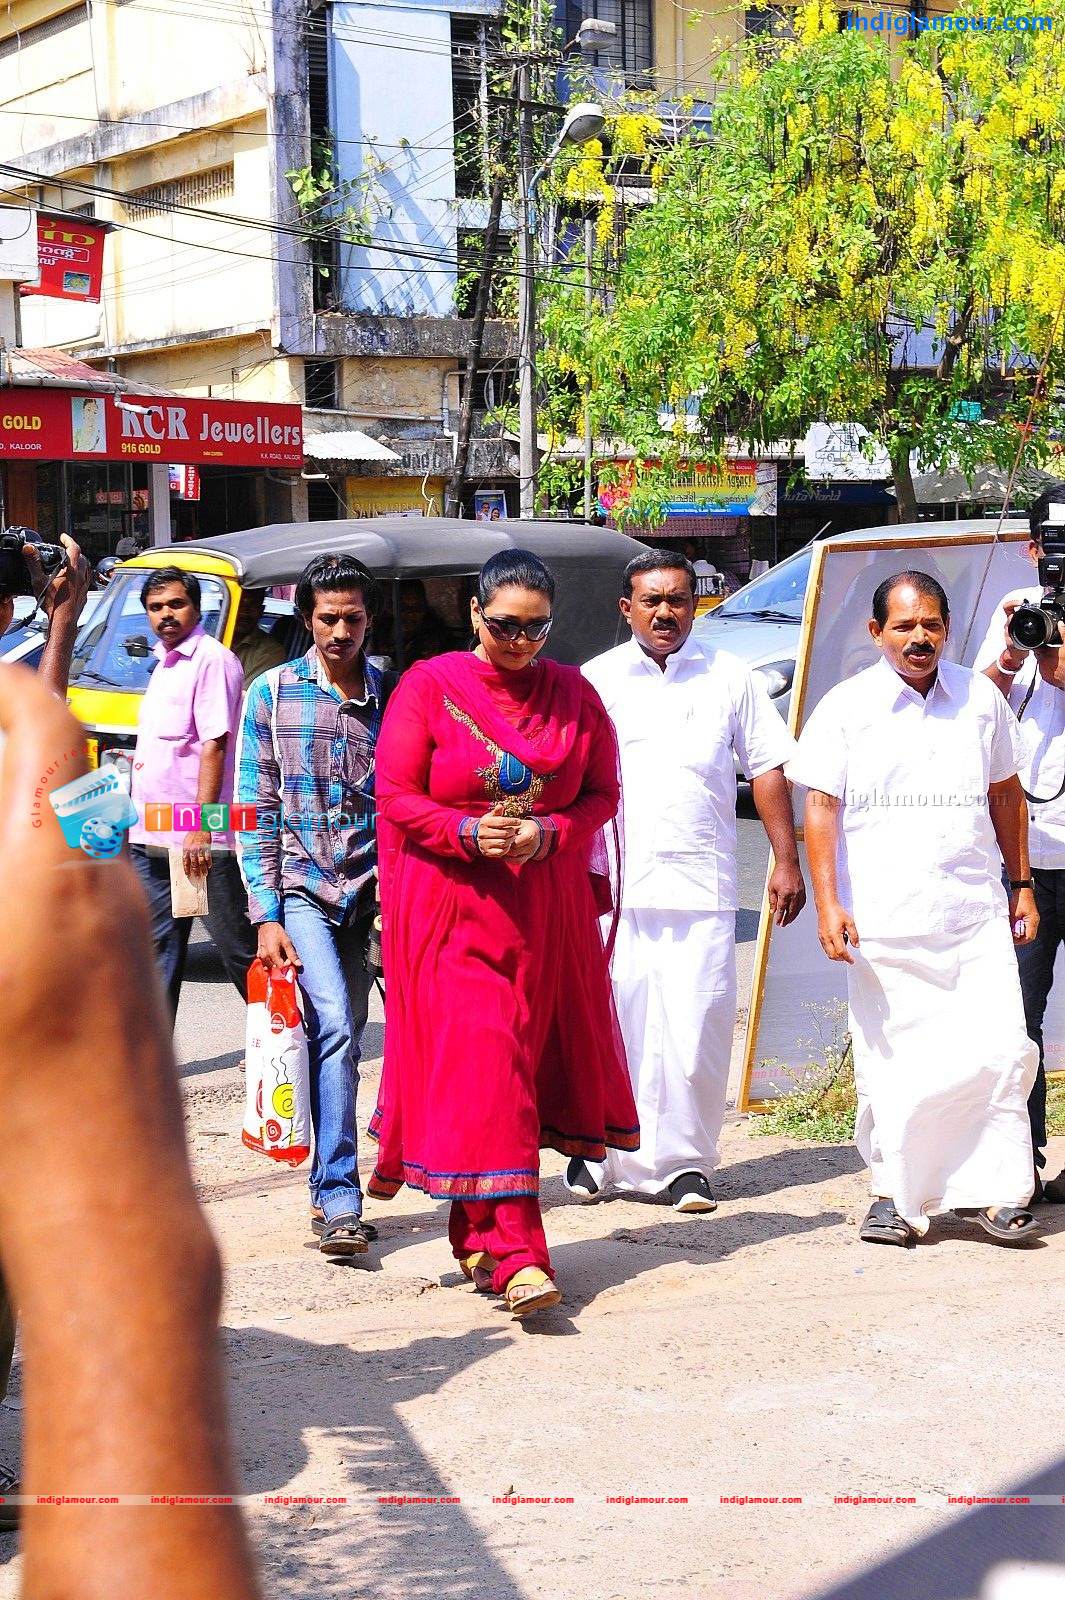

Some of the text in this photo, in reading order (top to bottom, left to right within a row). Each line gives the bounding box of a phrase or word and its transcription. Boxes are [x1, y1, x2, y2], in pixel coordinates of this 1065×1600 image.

[2, 415, 42, 430] GOLD
[121, 404, 301, 446] KCR Jewellers
[9, 443, 42, 451] KALOOR
[121, 443, 161, 455] 916 GOLD
